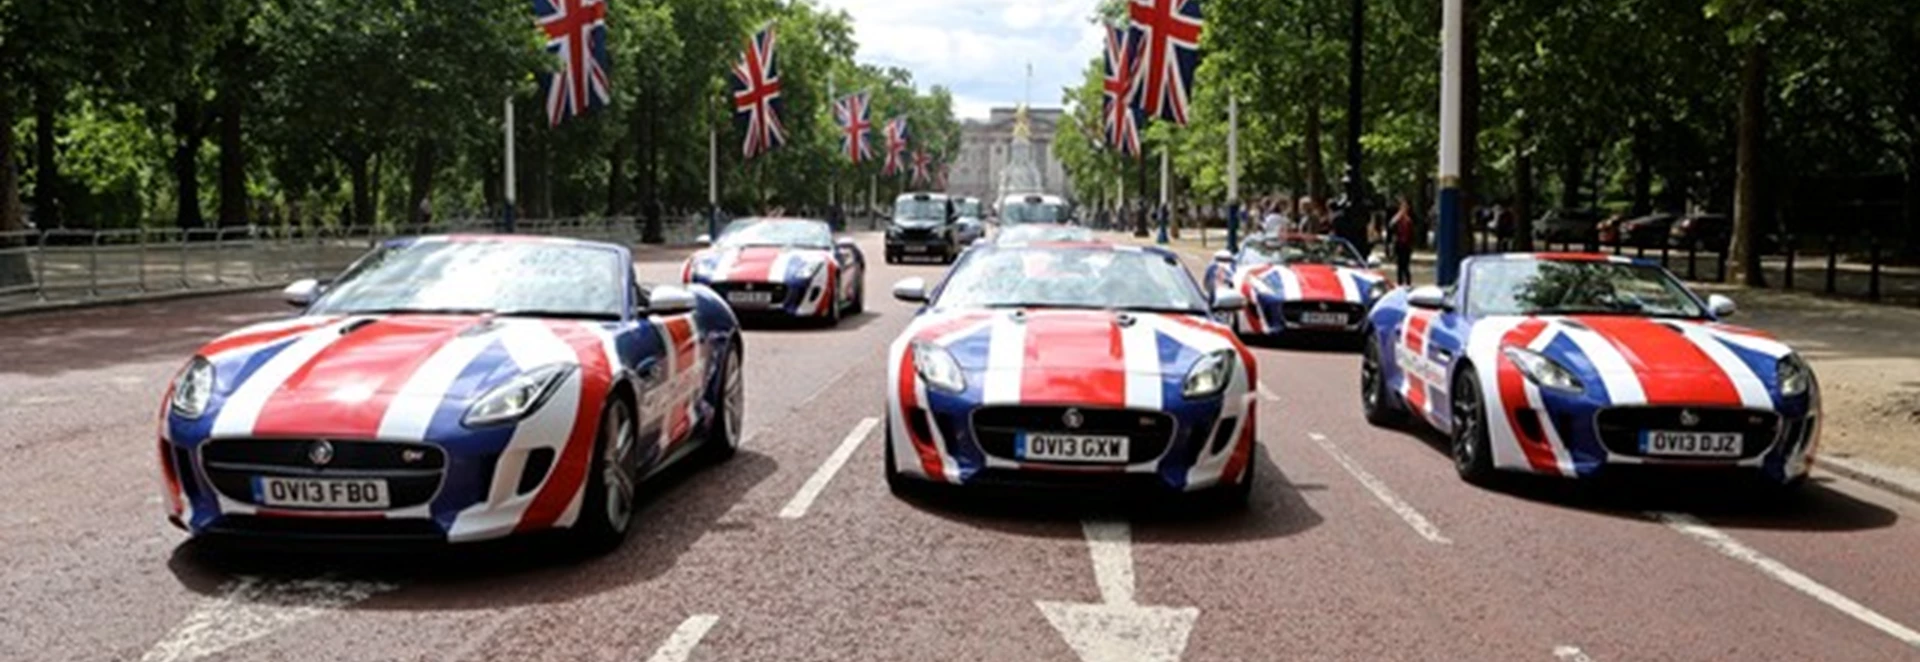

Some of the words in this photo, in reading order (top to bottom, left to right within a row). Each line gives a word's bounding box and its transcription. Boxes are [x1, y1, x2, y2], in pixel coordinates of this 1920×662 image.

[1031, 435, 1077, 456] OV13
[1081, 437, 1121, 457] GXW
[1654, 433, 1696, 451] OV13
[1700, 435, 1735, 453] DJZ
[270, 480, 324, 502] OV13
[329, 482, 379, 502] FBO
